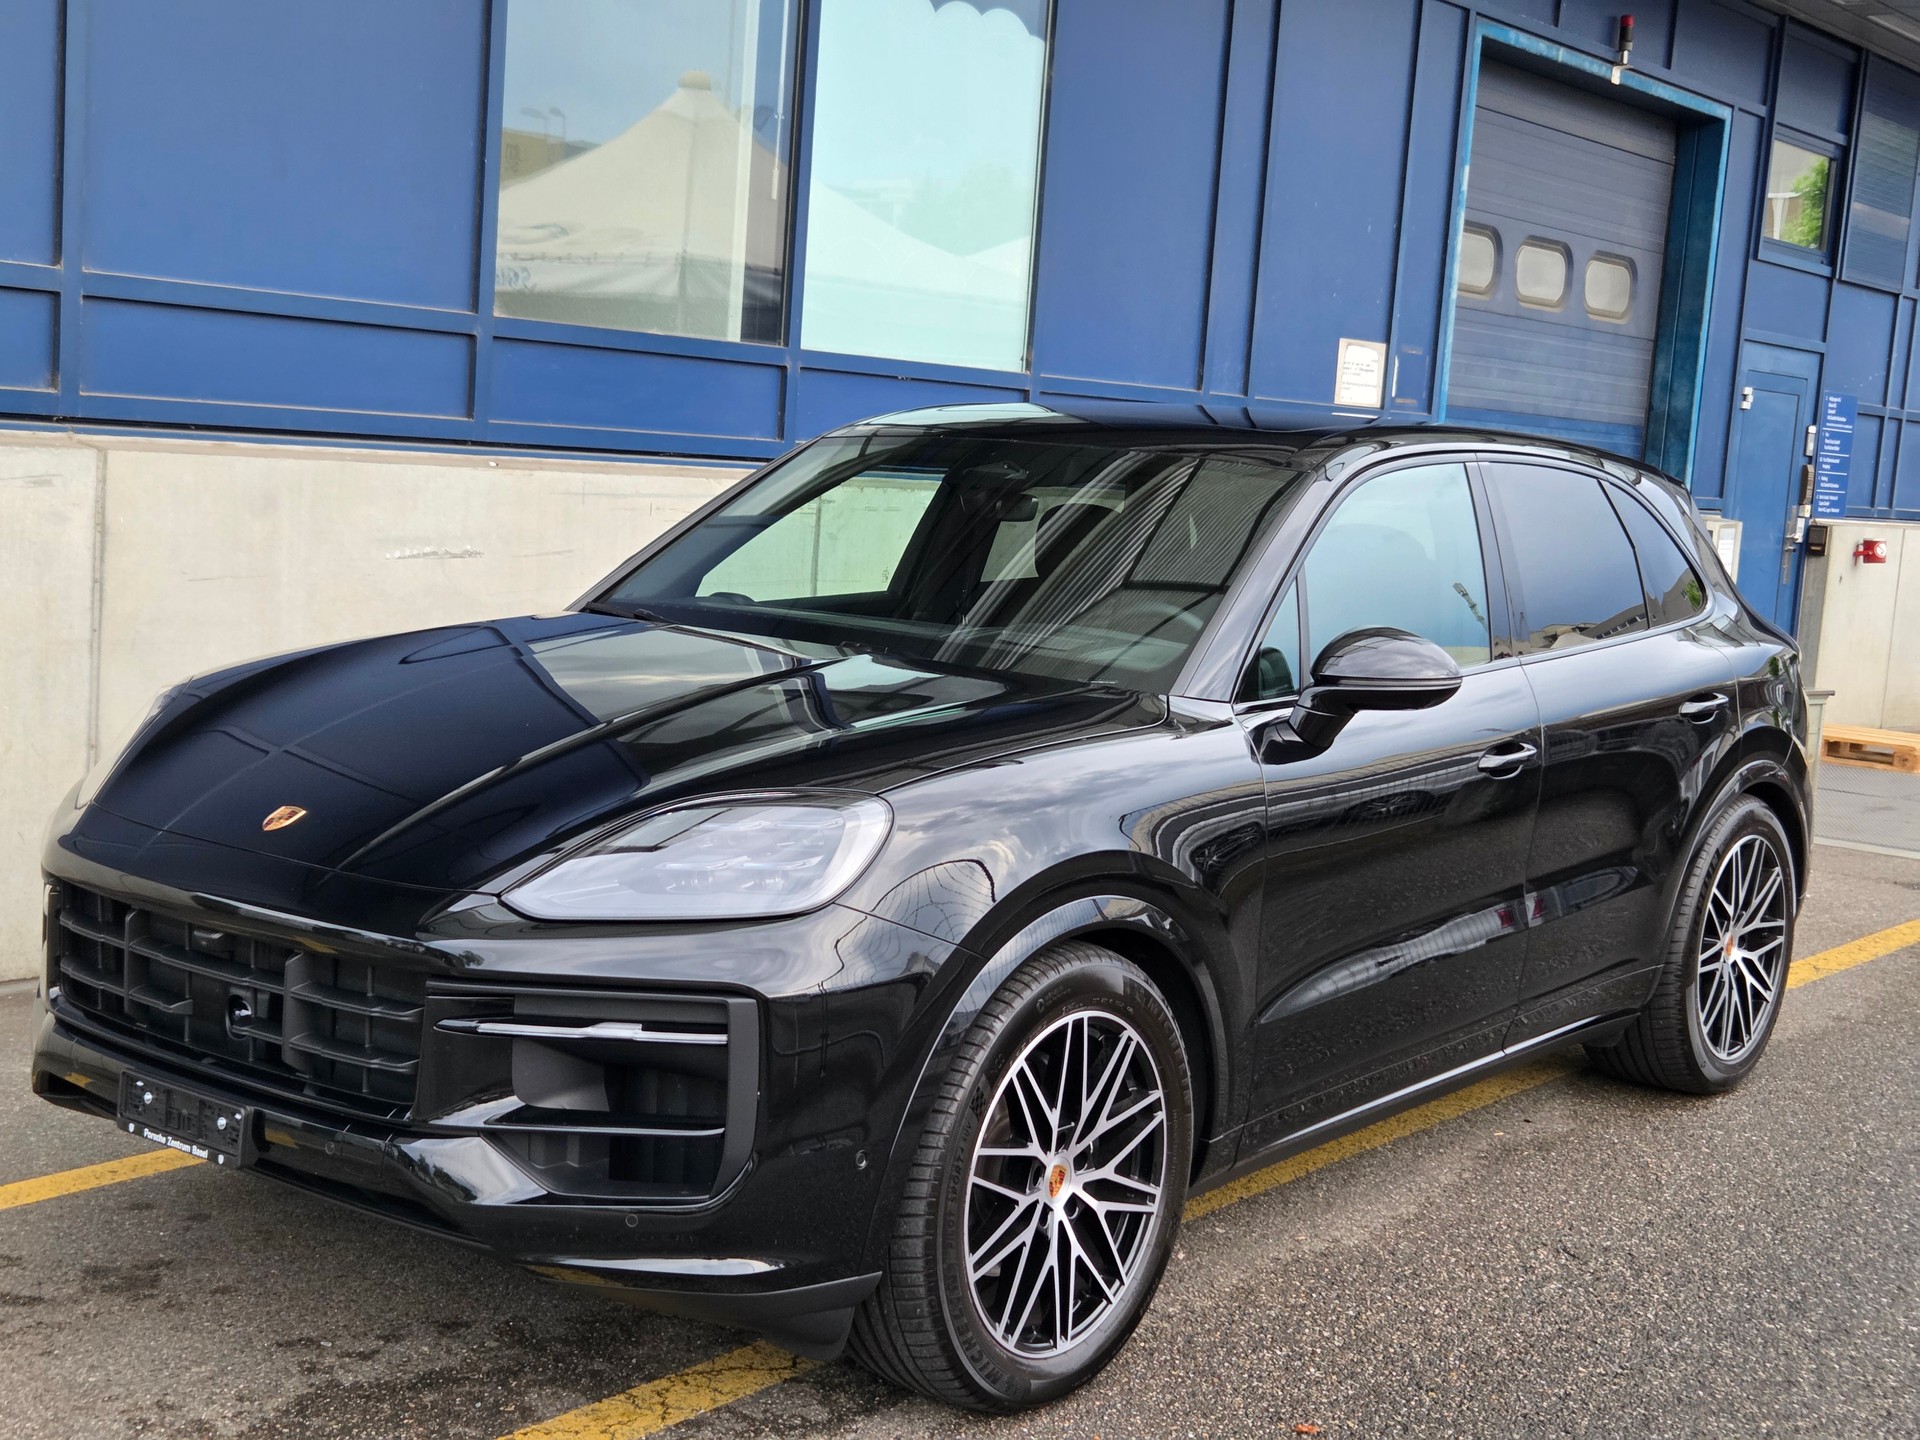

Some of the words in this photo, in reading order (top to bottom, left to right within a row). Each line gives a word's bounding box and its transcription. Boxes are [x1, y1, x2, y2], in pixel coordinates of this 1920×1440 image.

[1146, 996, 1192, 1107] MICHELIN
[143, 1127, 166, 1144] Porsche
[167, 1136, 190, 1153] Zentrum
[192, 1145, 208, 1159] Basel
[947, 1155, 965, 1203] SPORT
